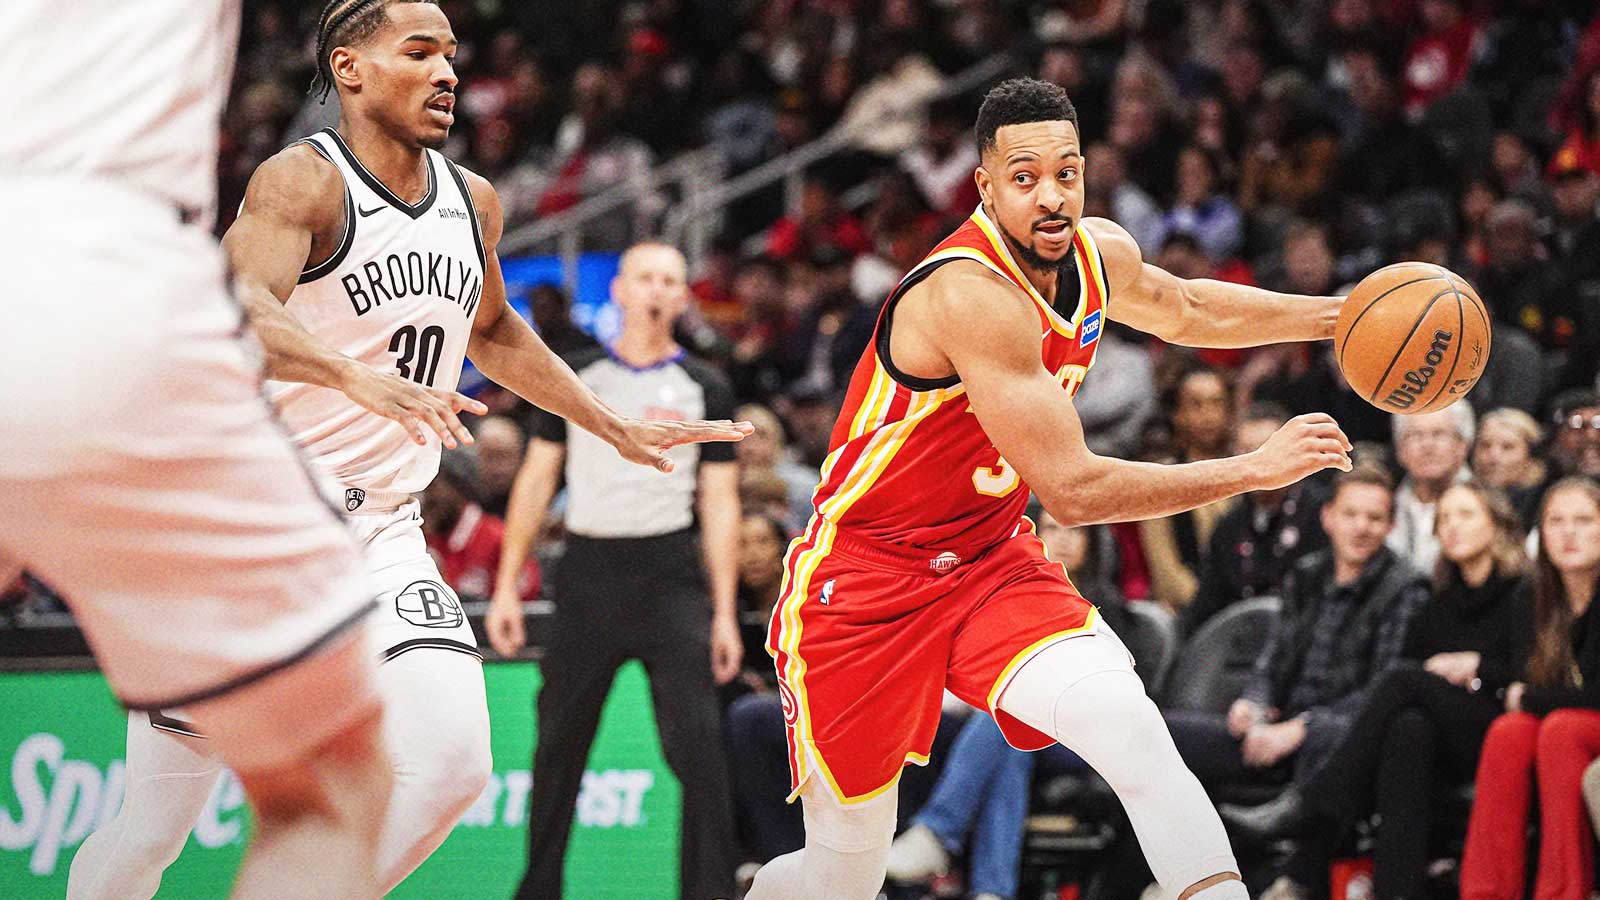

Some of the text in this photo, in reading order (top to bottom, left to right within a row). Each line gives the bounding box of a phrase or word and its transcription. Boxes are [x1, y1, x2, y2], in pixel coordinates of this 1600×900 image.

[341, 251, 481, 319] BROOKLYN
[388, 325, 445, 388] 30
[1383, 329, 1453, 409] Wilson
[346, 489, 364, 501] NETS
[929, 557, 961, 570] HAWKS
[418, 588, 445, 620] B
[0, 732, 245, 876] Spe
